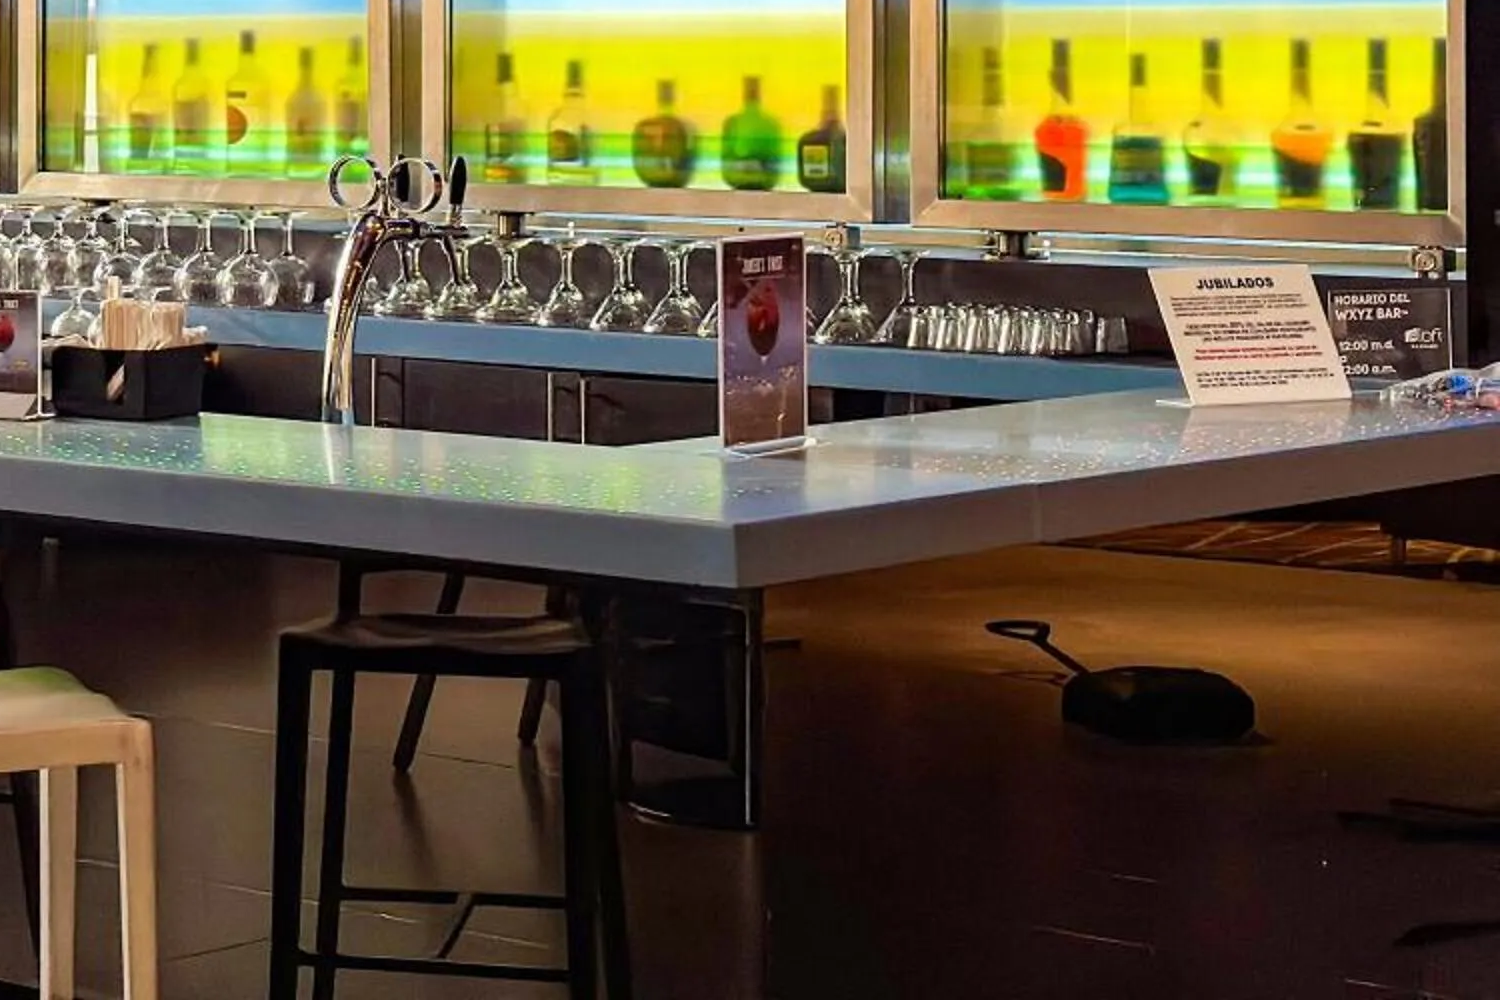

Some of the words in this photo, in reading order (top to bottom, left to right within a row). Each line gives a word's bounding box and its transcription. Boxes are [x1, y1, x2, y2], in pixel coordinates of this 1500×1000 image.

[1196, 277, 1275, 290] JUBILADOS
[1333, 293, 1387, 306] HORARIO
[1389, 293, 1411, 304] DEL
[1335, 308, 1375, 321] WXYZ
